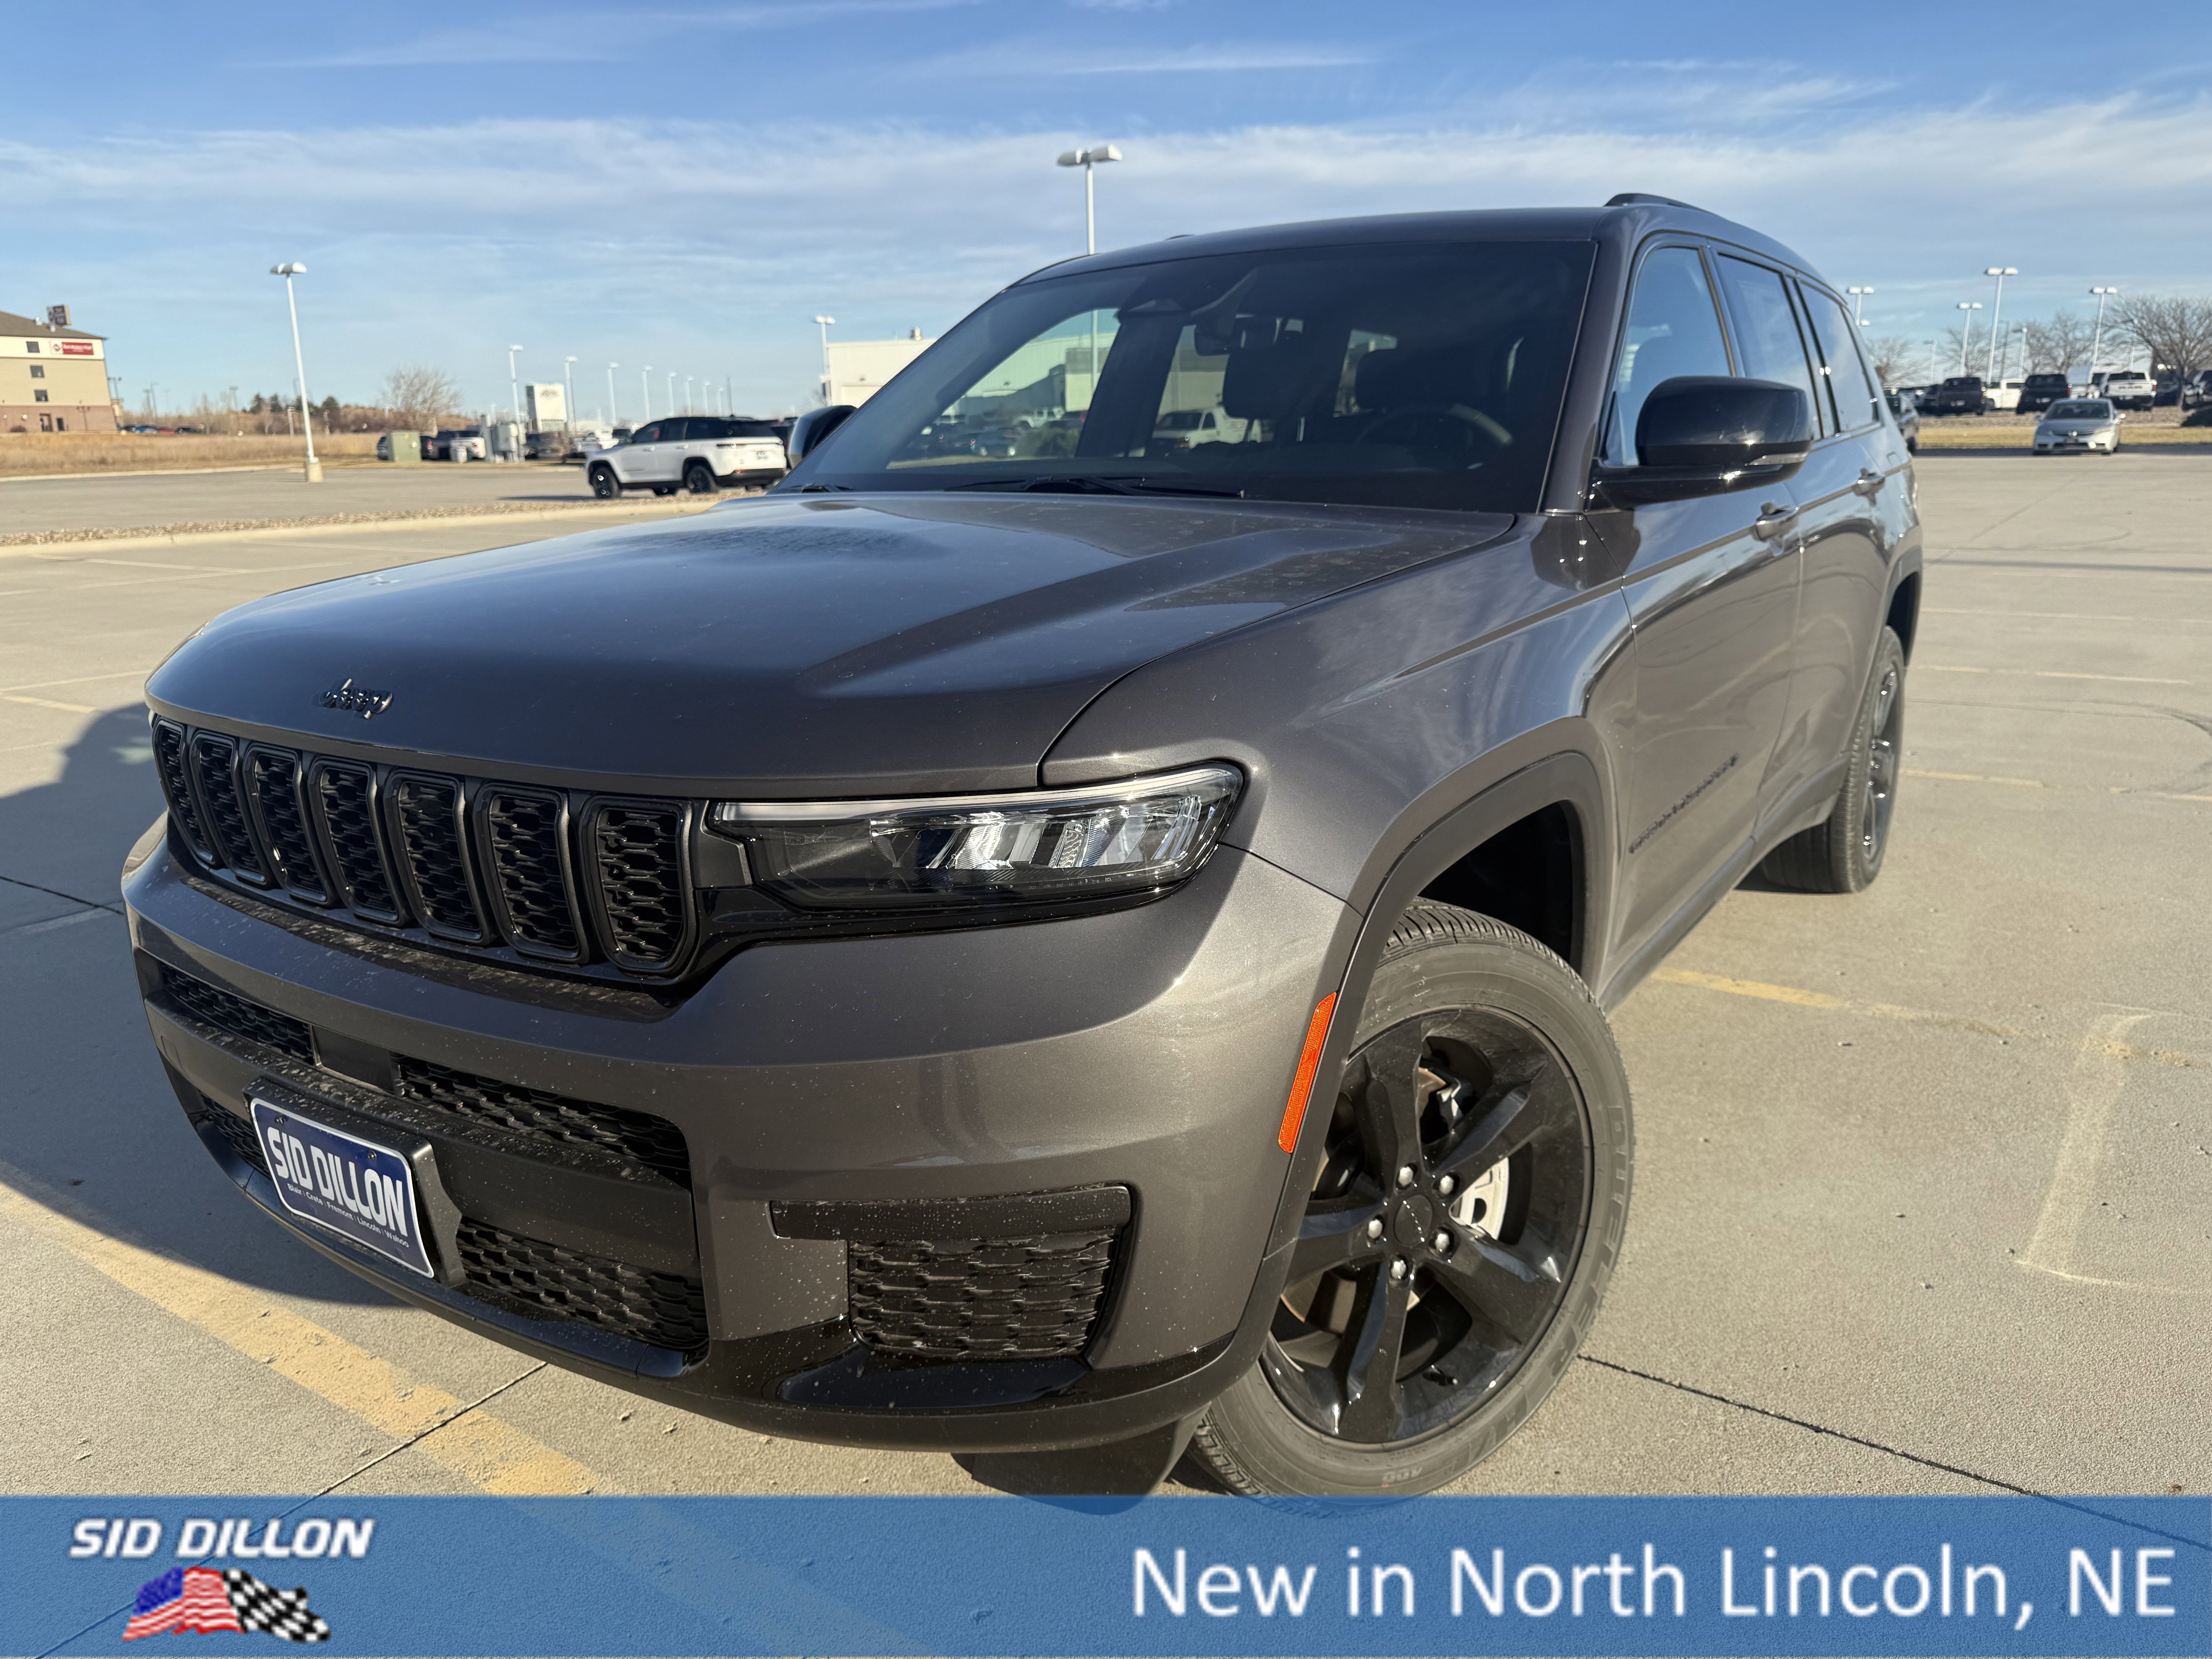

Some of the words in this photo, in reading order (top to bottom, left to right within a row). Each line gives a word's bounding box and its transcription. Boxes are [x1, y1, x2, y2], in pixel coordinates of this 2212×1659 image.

[268, 1127, 313, 1190] SID
[310, 1145, 408, 1237] DILLON
[287, 1183, 302, 1196] Blair
[306, 1193, 323, 1206] Crete
[327, 1202, 353, 1221] Fremont
[357, 1218, 381, 1234] Lincoln
[385, 1230, 409, 1248] Wahoo
[1546, 1105, 1626, 1379] DUELER
